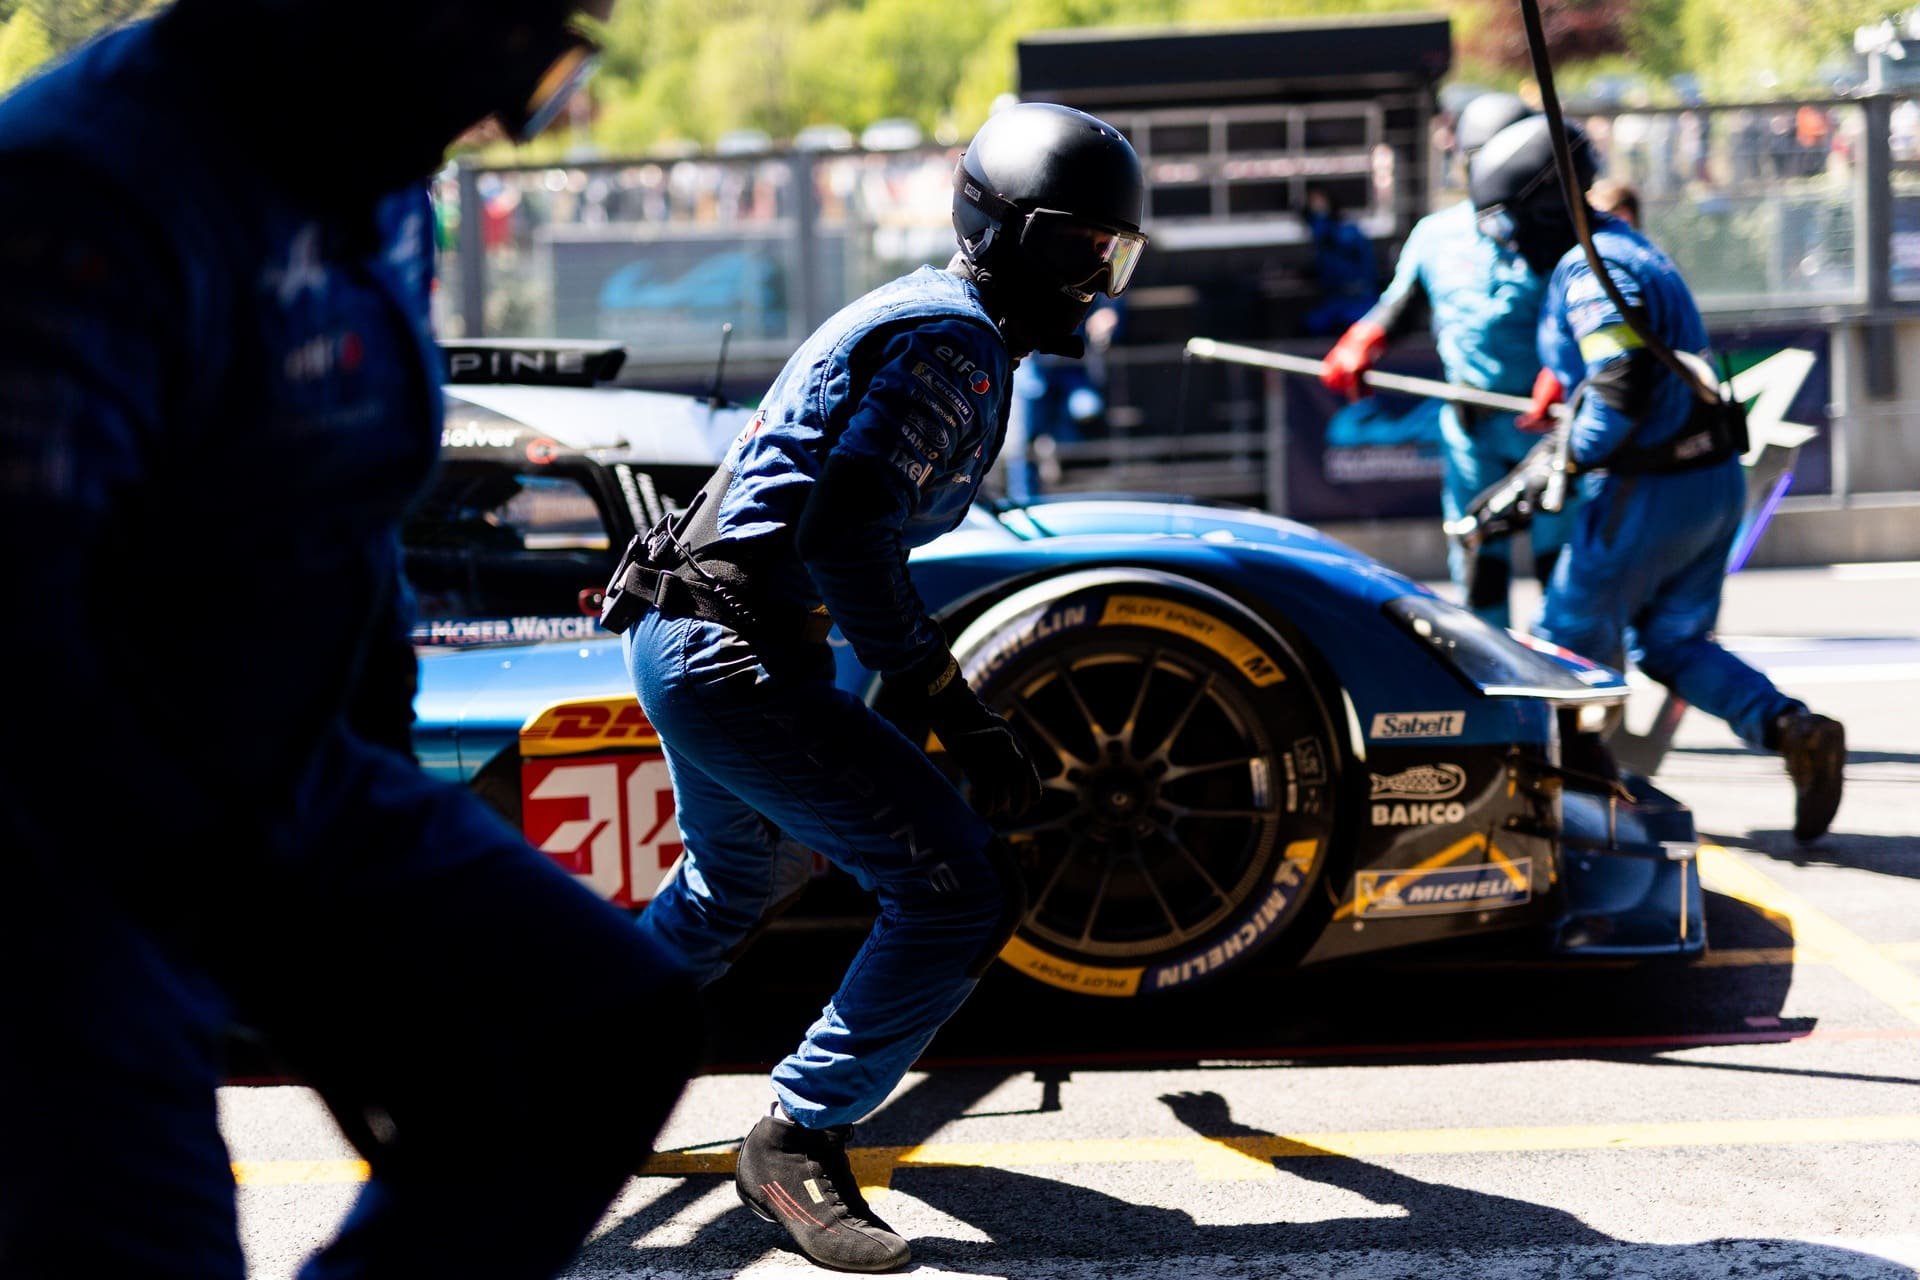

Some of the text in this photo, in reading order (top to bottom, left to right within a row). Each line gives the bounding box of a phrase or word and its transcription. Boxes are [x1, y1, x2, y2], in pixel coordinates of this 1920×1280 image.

[935, 346, 976, 374] elf
[1117, 604, 1273, 680] PILOT SPORT M
[1382, 715, 1455, 737] Sabelt
[1371, 803, 1467, 826] BAHCO
[1157, 889, 1288, 988] MICHELIN
[1028, 960, 1128, 990] PILOT SPORT
